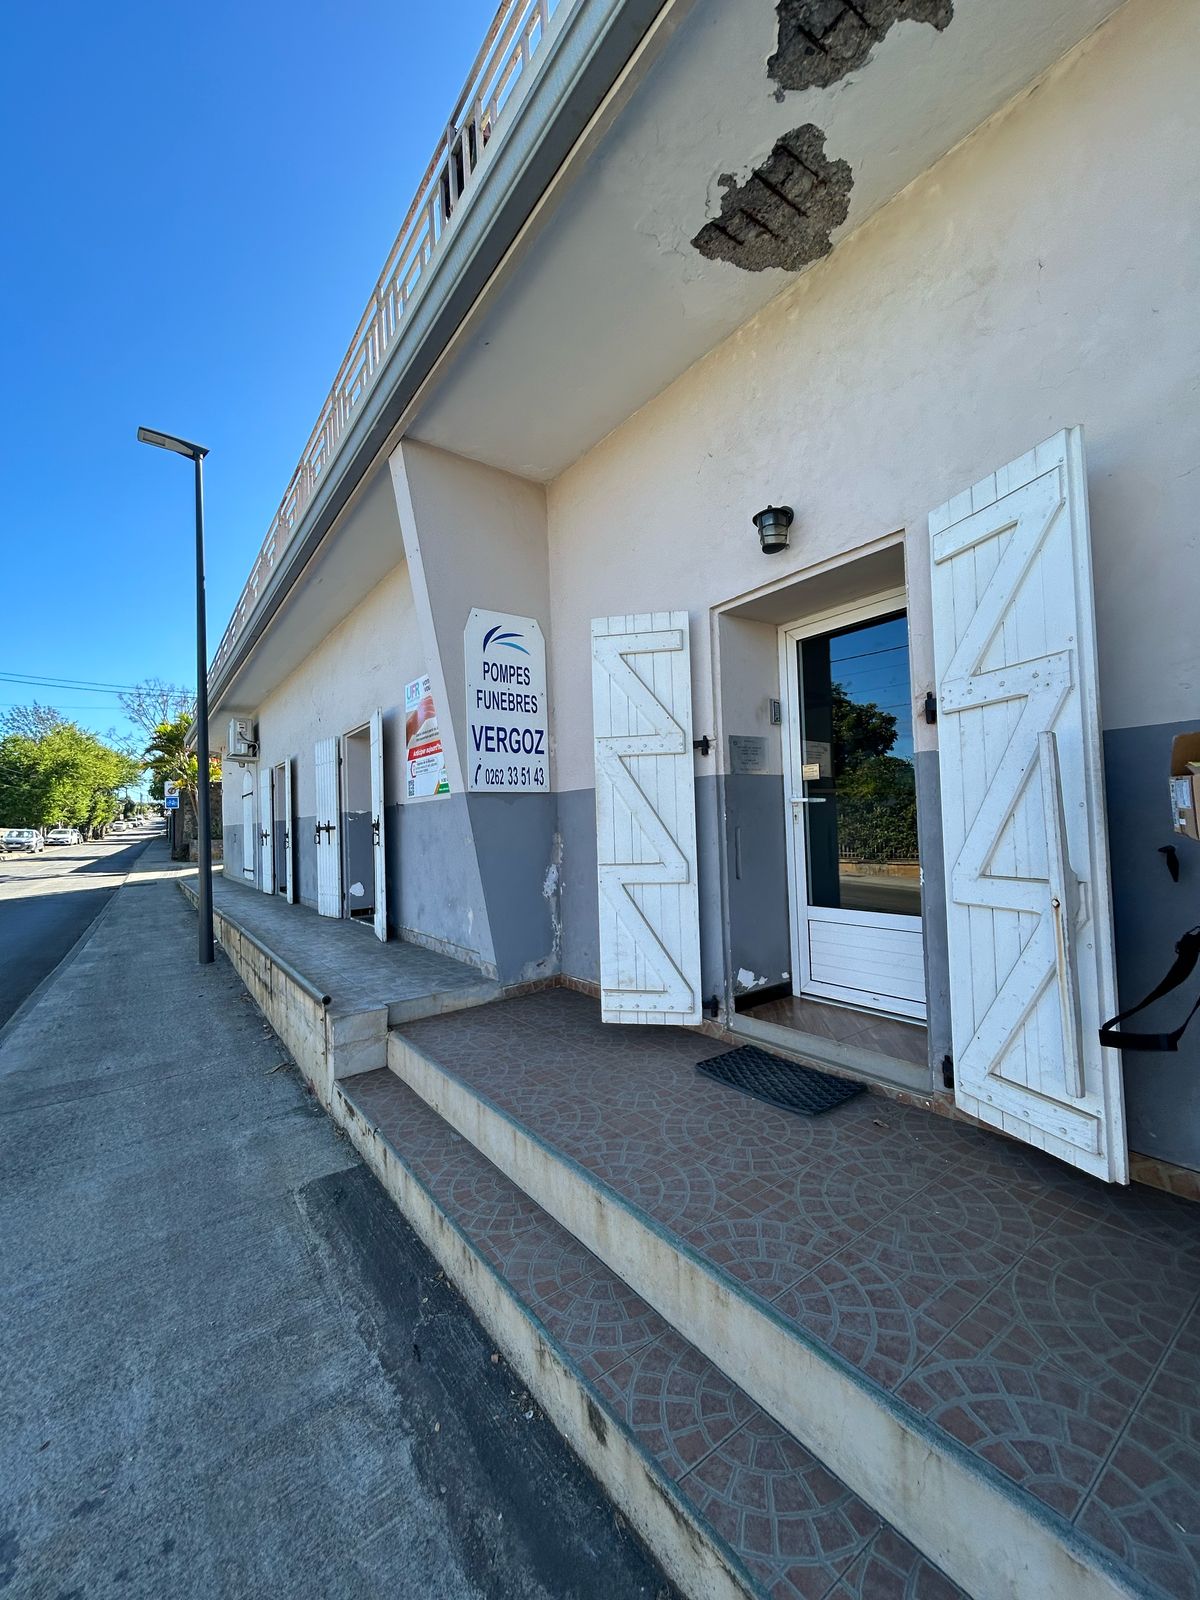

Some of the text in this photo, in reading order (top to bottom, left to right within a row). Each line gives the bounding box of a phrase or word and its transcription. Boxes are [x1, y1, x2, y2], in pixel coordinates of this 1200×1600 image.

[483, 661, 531, 686] POMPES
[476, 689, 538, 714] FUNEBRES
[471, 724, 545, 755] VERGOZ
[485, 766, 545, 786] 0262 33 51 43
